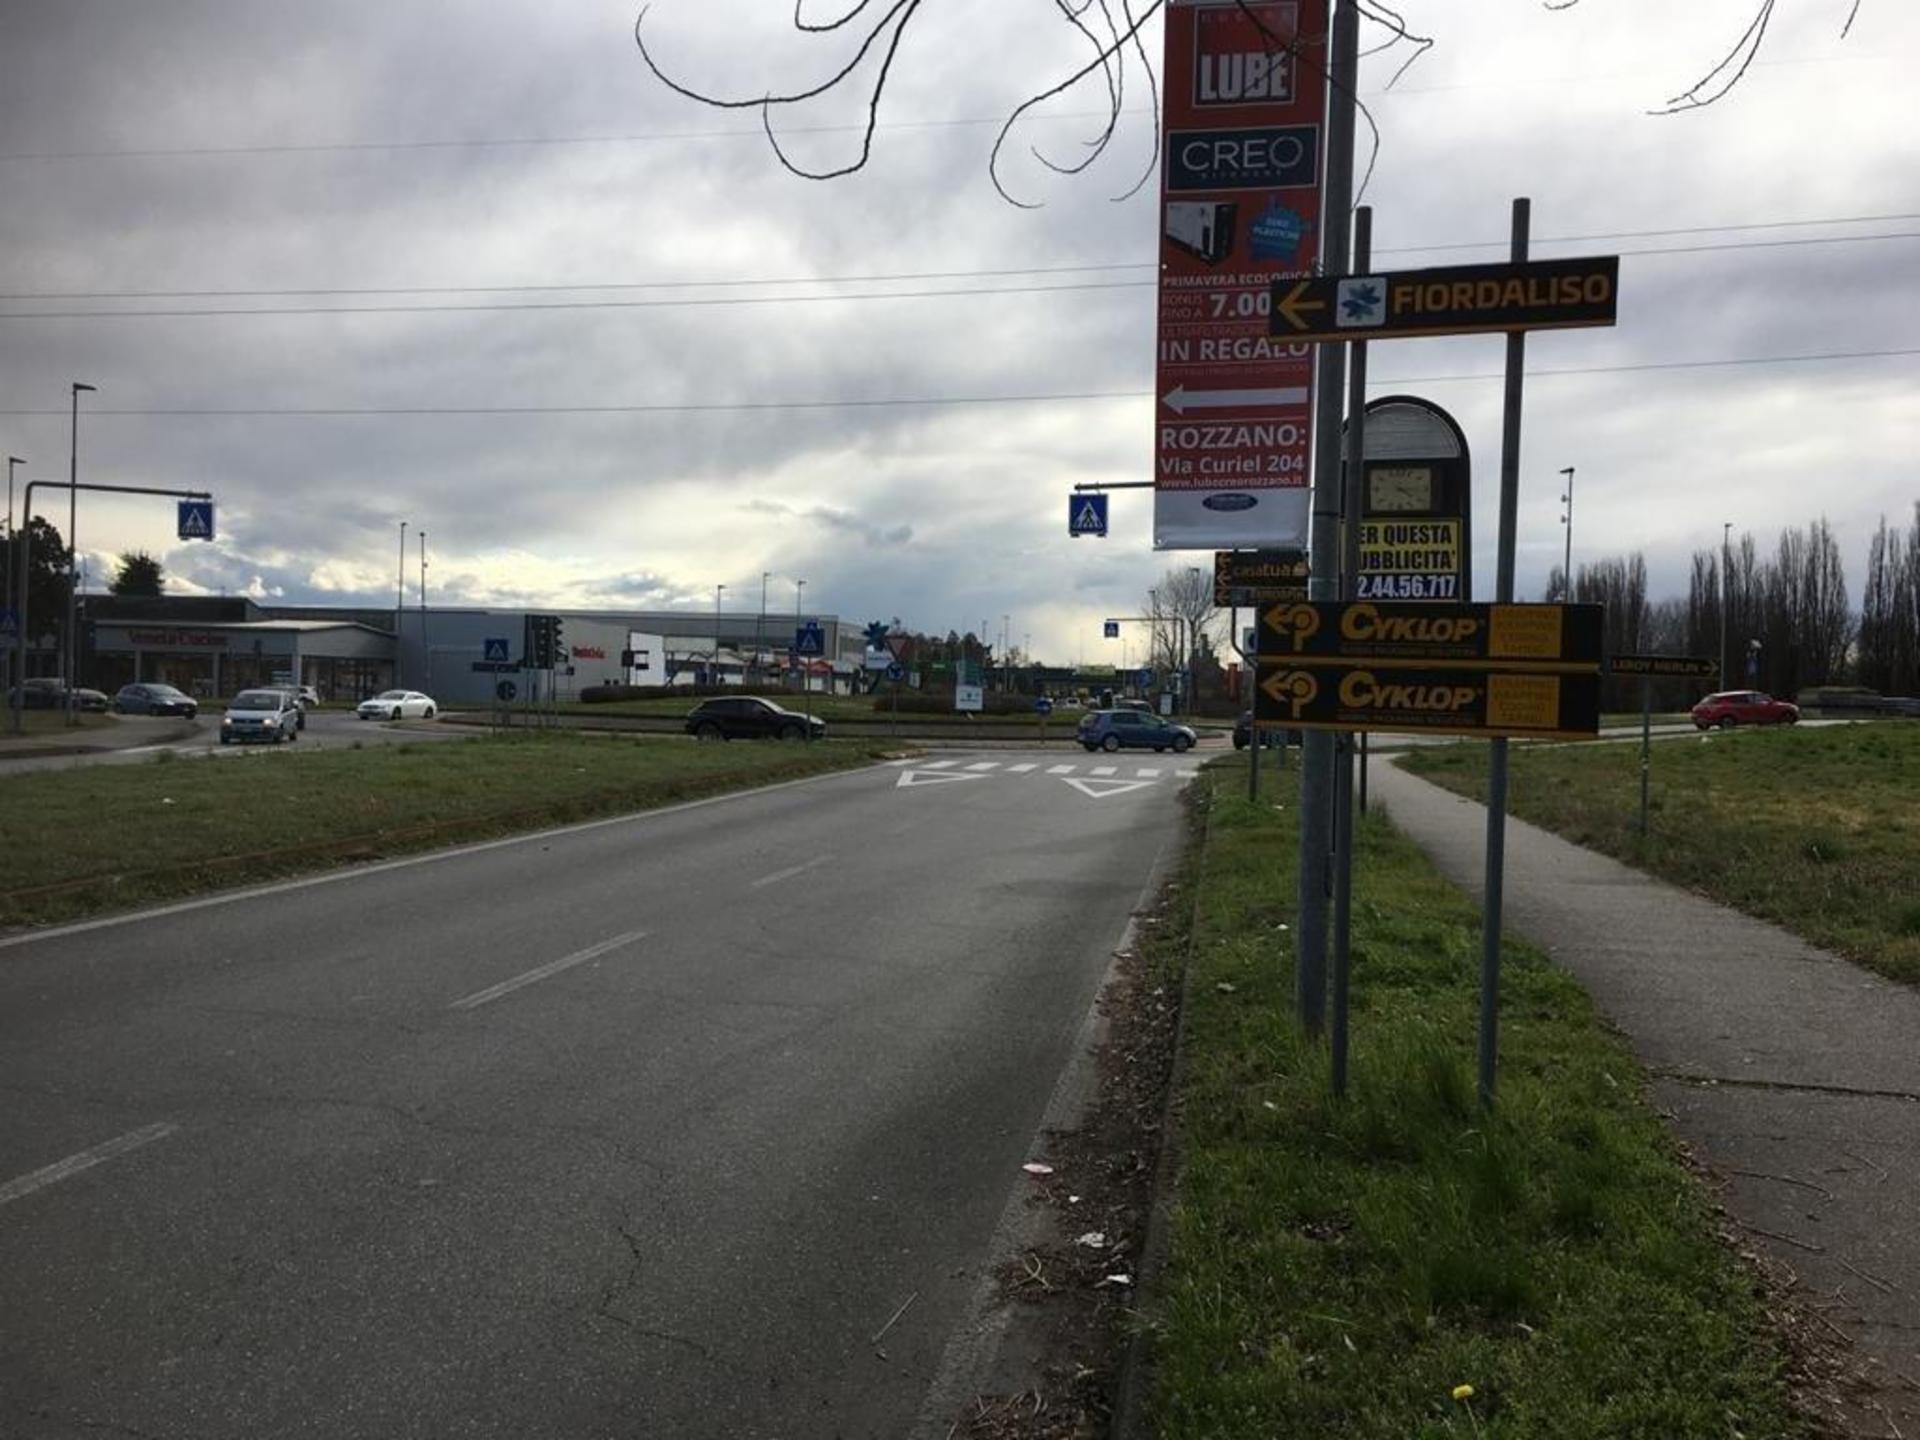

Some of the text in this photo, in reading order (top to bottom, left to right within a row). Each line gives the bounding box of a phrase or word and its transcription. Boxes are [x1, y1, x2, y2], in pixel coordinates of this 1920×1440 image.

[1182, 136, 1304, 171] CREO
[1161, 273, 1237, 287] PRIMAVERA
[1209, 291, 1271, 318] 7.00
[1394, 273, 1610, 315] FIORDALISO
[1161, 336, 1310, 361] IN REGALO
[1161, 424, 1306, 450] ROZZANO:
[1160, 454, 1305, 475] Via Curiel 204
[1360, 524, 1453, 547] ER QUESTA
[1358, 574, 1456, 598] 2.44.56.717
[1340, 603, 1478, 641] CYKLOP
[1338, 670, 1477, 710] CYKLOP
